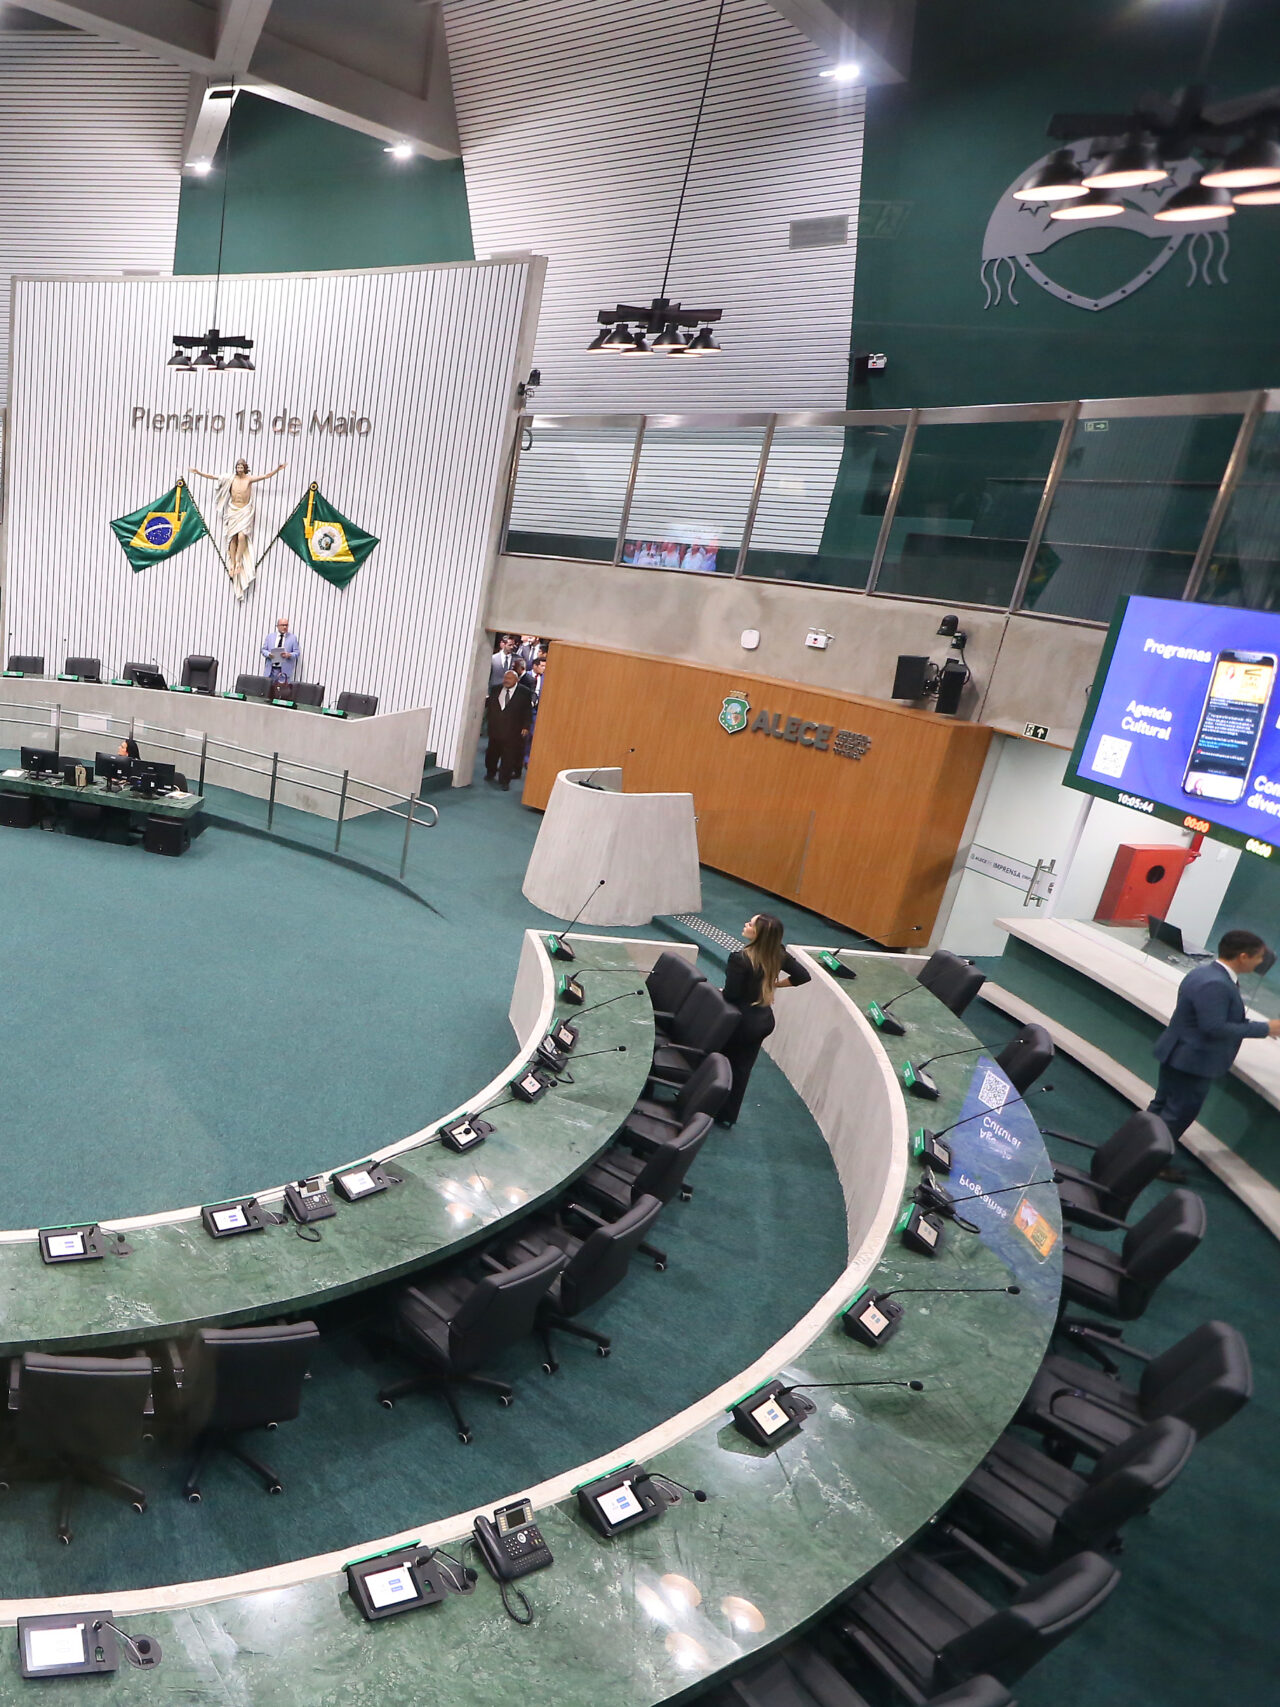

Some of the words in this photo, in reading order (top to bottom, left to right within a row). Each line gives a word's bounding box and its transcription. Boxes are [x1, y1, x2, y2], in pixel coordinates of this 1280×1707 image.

[130, 405, 226, 433] Plenário
[235, 408, 264, 434] 13
[271, 407, 303, 436] de
[309, 409, 372, 438] Maio
[1143, 638, 1212, 663] Programas
[1125, 699, 1173, 722] Agenda
[751, 710, 834, 751] ALECE
[1121, 716, 1172, 740] Cultural
[1183, 815, 1210, 834] 00:00
[992, 862, 1021, 878] IMPRENSA
